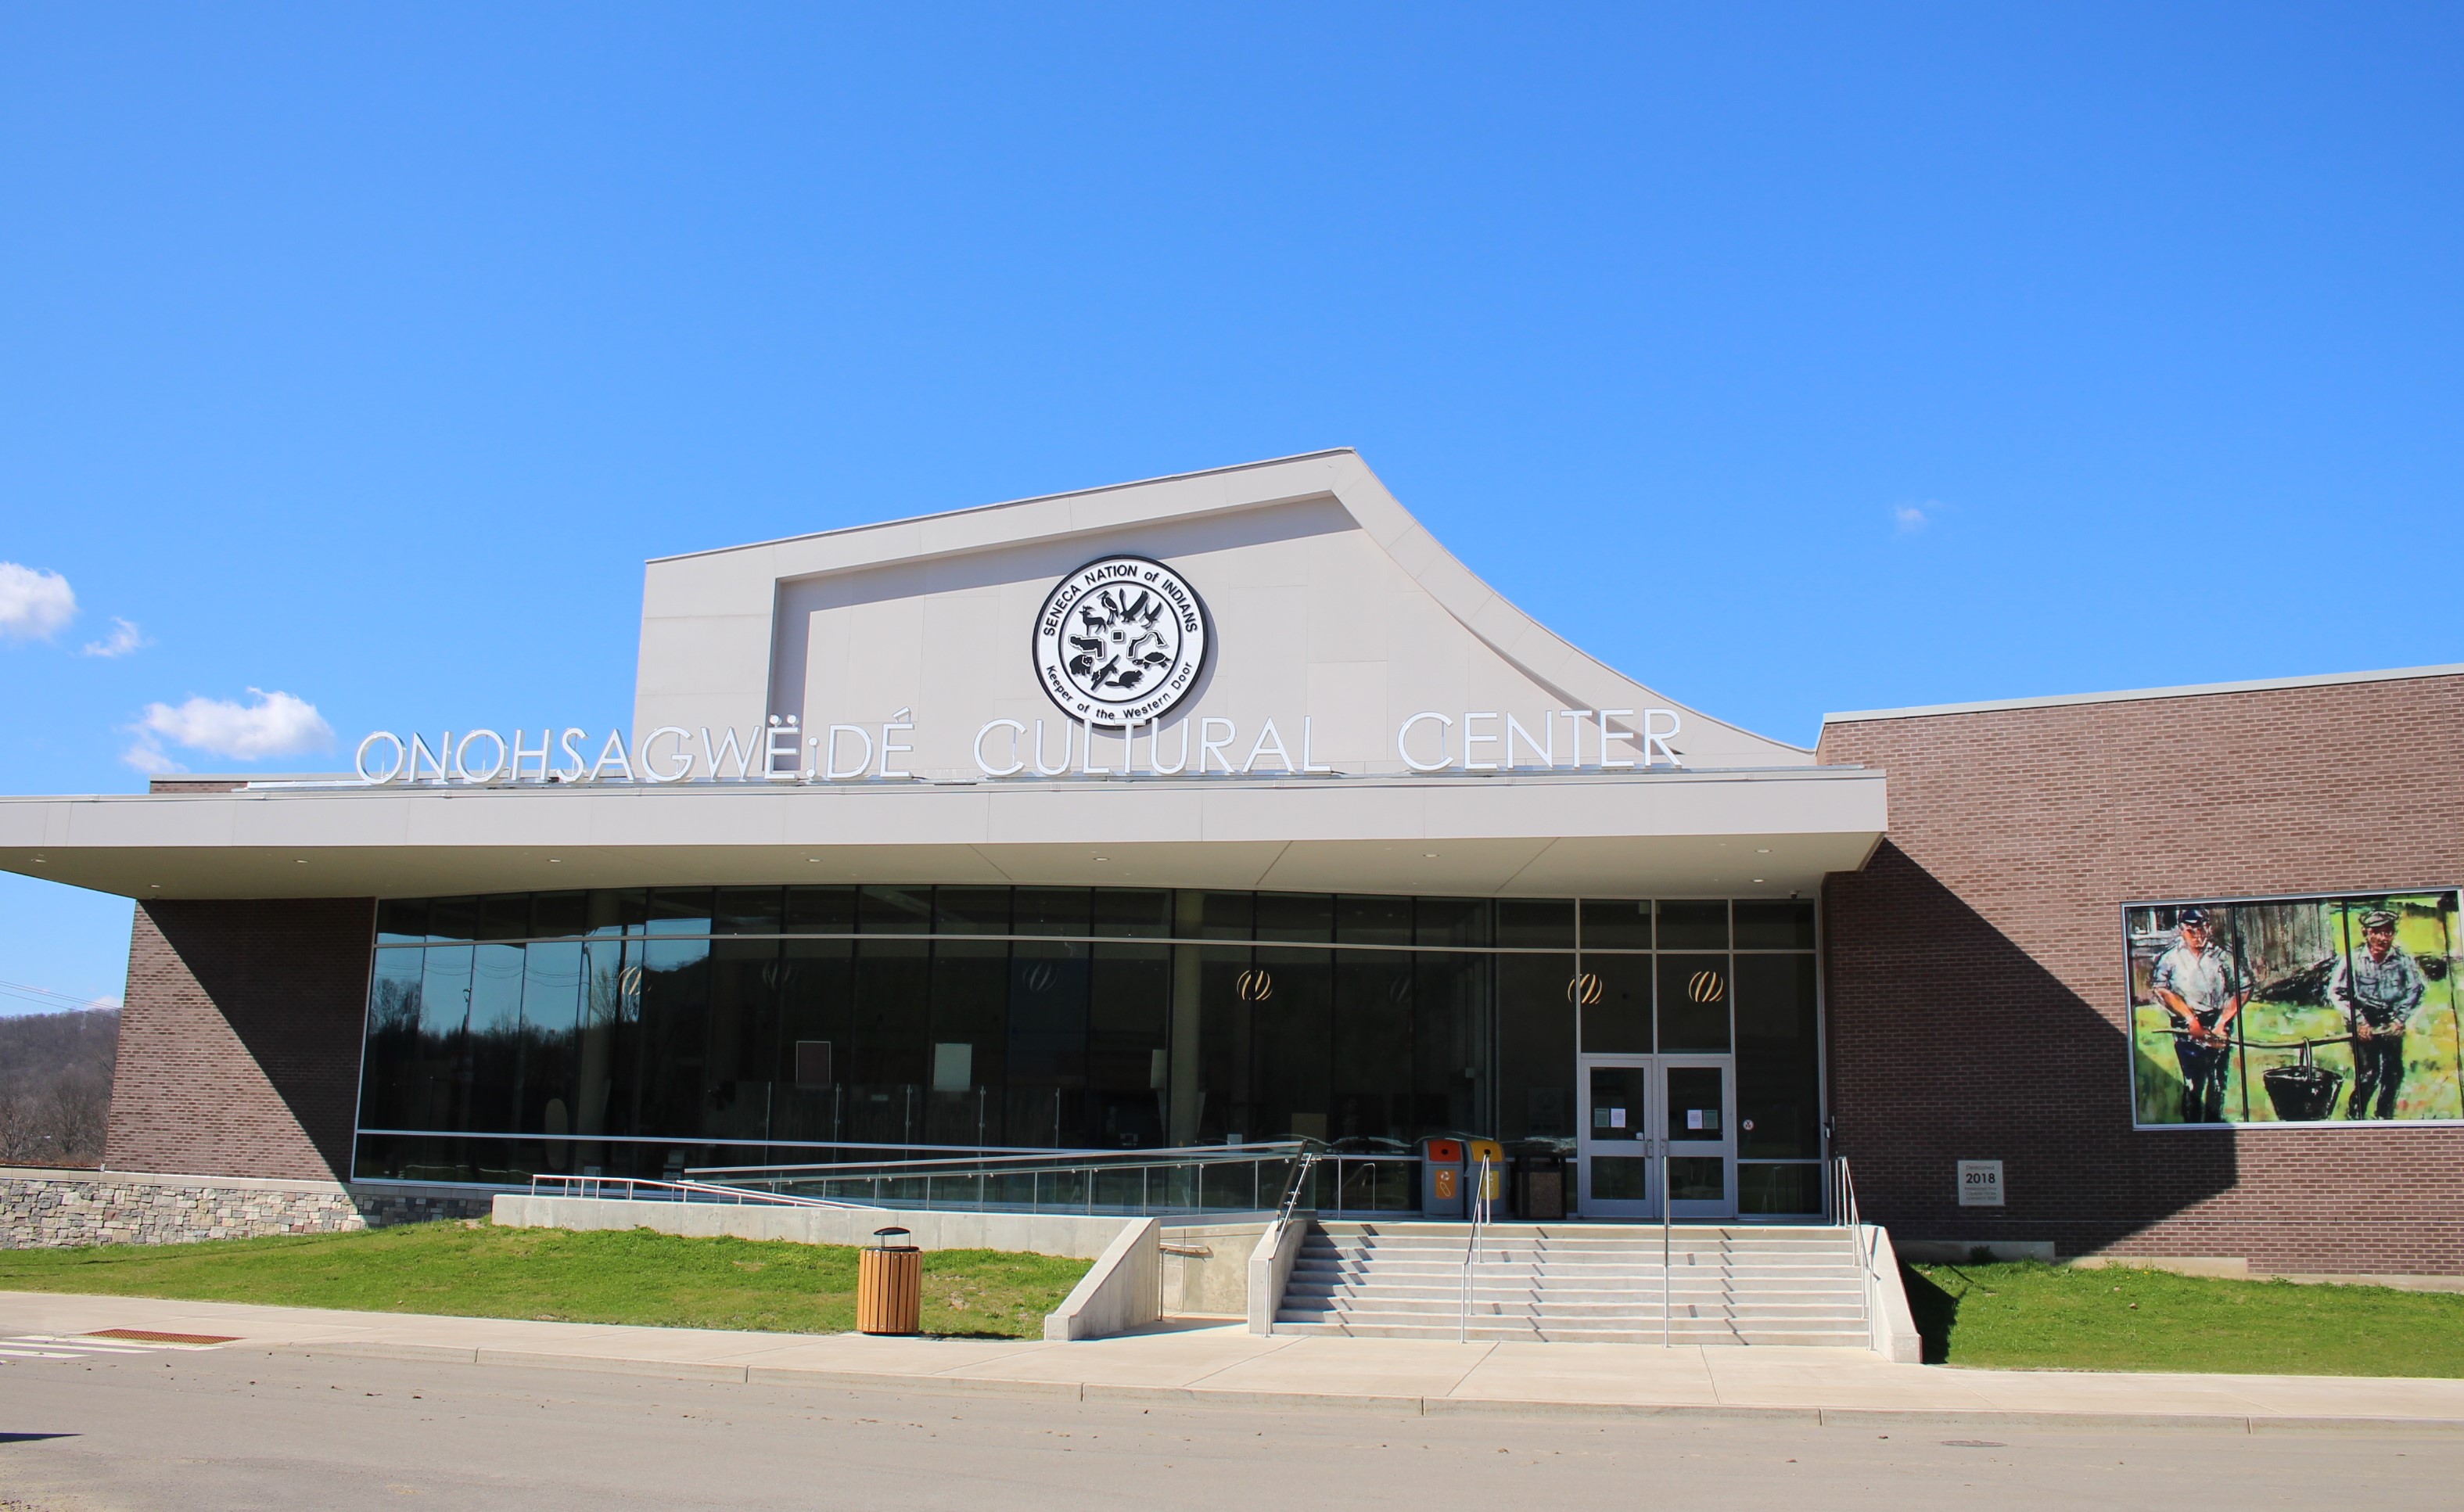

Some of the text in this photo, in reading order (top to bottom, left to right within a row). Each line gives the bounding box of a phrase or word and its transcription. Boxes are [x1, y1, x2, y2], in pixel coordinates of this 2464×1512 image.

[1043, 565, 1198, 637] SENECA NATION of INDIANS
[1046, 663, 1192, 720] Keeper of the Western Door
[973, 716, 1333, 776] CULTURAL
[1395, 708, 1683, 772] CENTER
[1966, 1173, 1995, 1183] 2018
